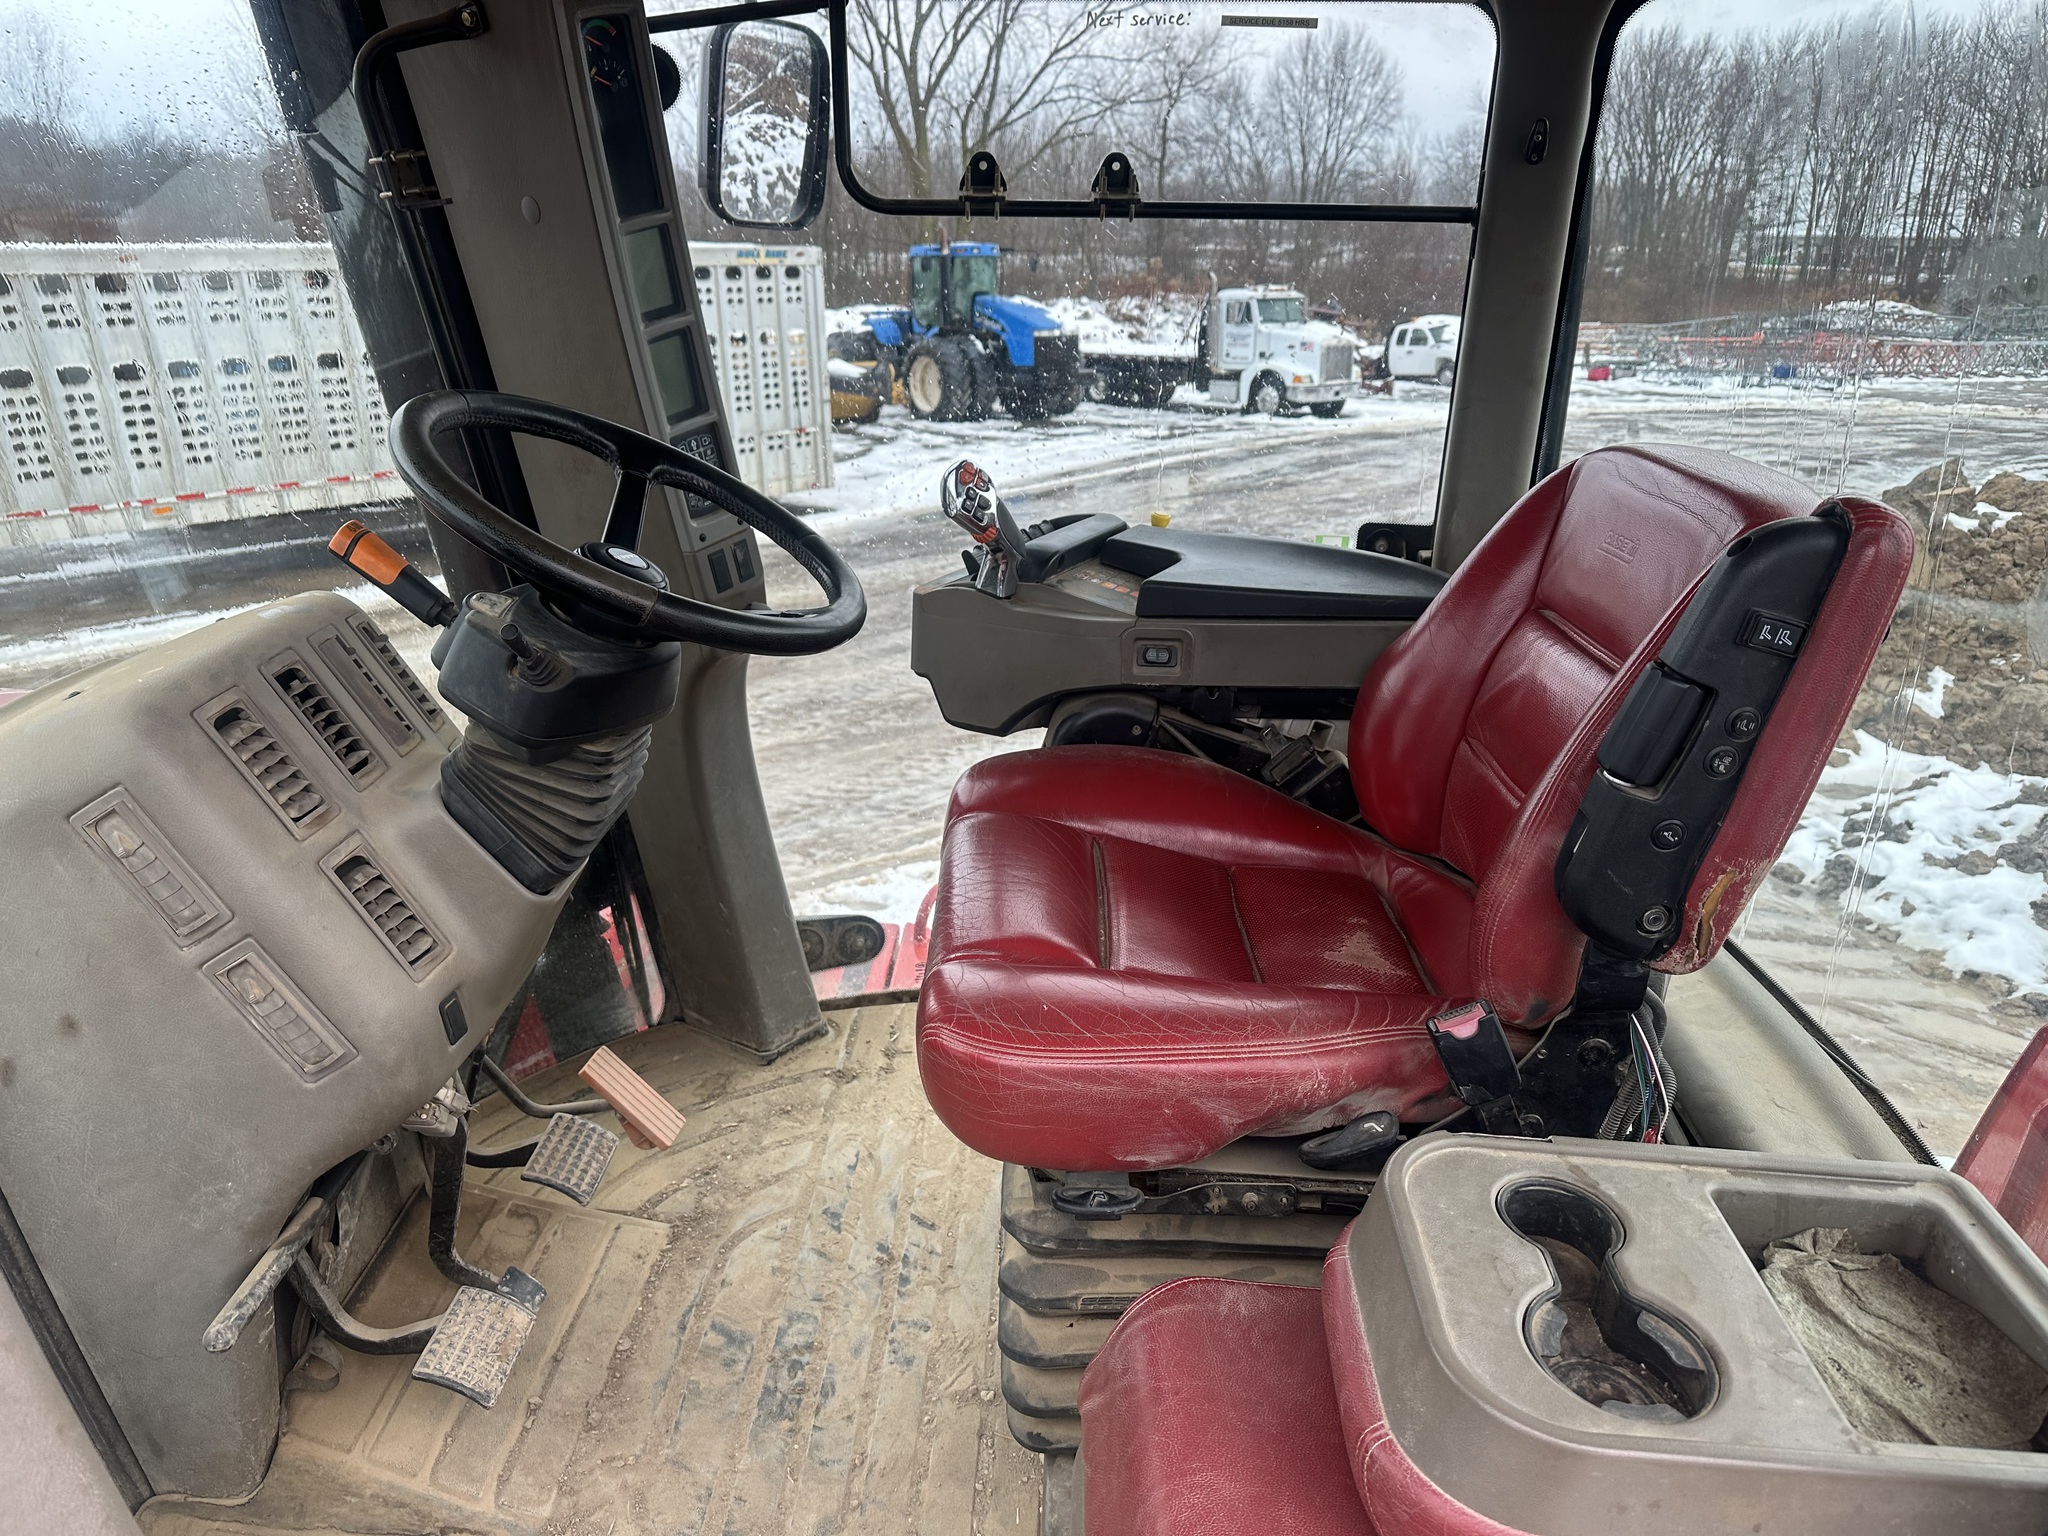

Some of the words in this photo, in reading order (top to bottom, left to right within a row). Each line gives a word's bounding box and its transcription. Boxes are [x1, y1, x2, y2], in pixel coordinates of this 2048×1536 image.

[1087, 11, 1124, 28] Next
[1130, 12, 1191, 26] service:
[1229, 17, 1260, 25] SERVICE
[1261, 18, 1276, 26] DUE
[1294, 19, 1310, 27] HRS
